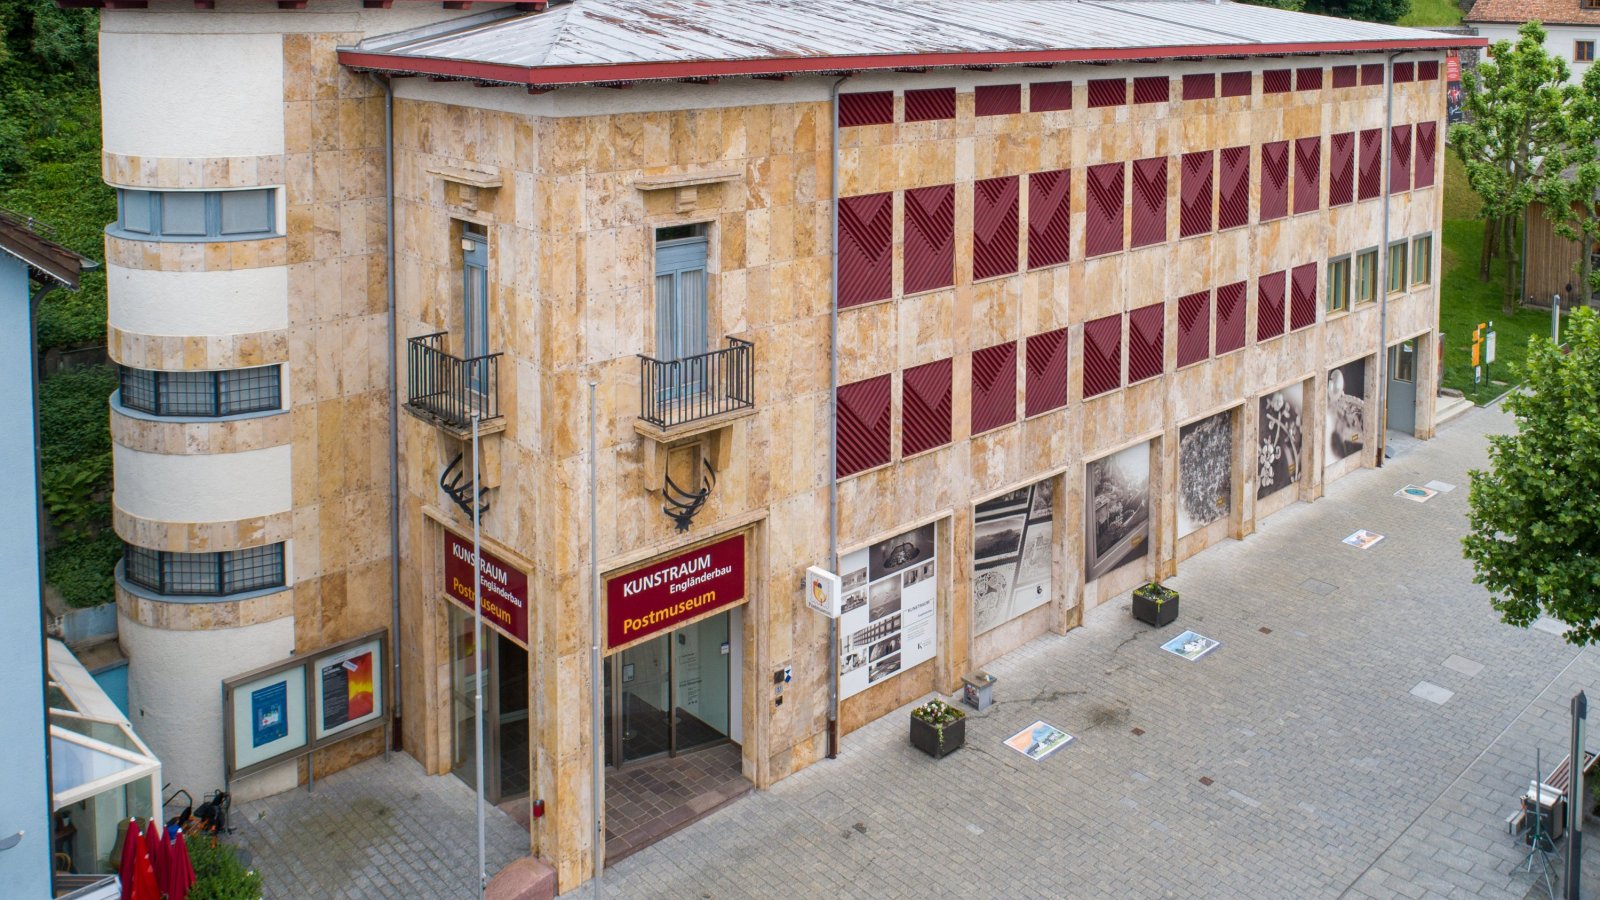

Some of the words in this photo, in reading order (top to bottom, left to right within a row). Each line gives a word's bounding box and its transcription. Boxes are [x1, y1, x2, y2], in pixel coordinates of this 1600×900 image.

[452, 542, 507, 586] KUNSRAUM
[623, 554, 711, 597] KUNSTRAUM
[669, 564, 732, 595] Engländerbau
[480, 575, 522, 608] Engländerbau
[623, 588, 716, 634] Postmuseum
